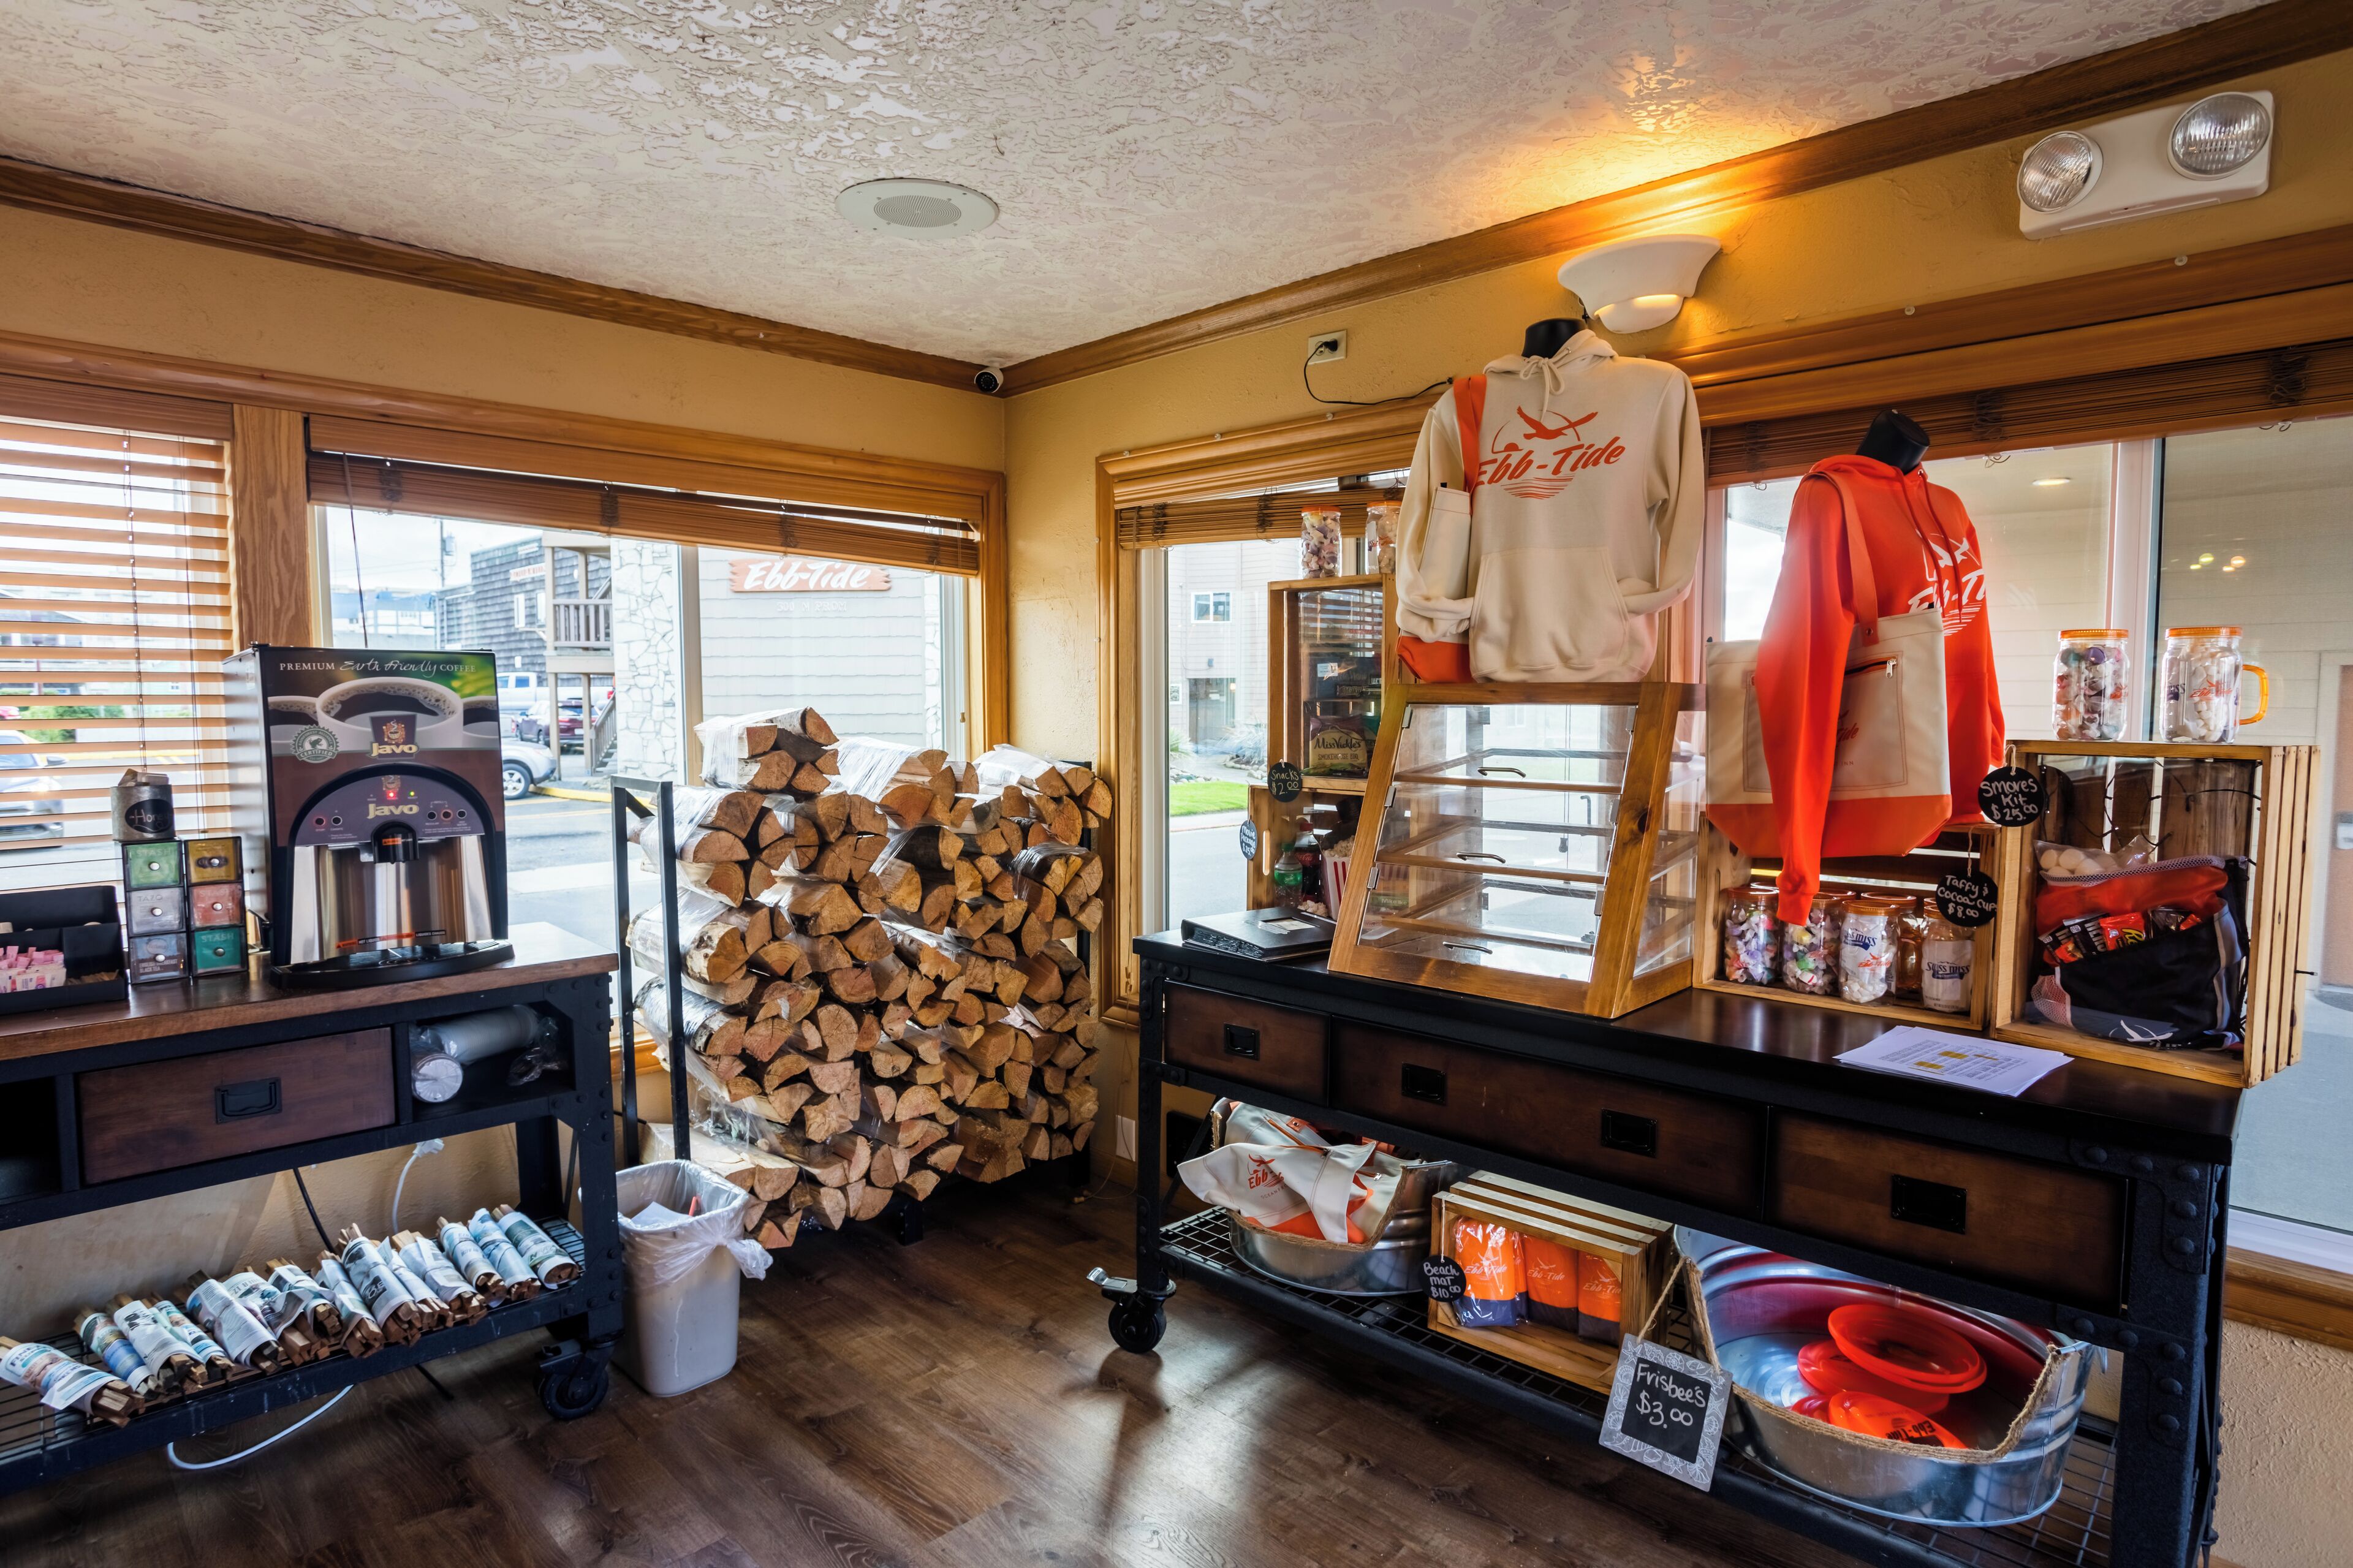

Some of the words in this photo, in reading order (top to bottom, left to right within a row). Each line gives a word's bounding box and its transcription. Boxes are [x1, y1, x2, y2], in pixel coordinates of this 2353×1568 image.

[743, 560, 872, 589] Ebb-Tide
[776, 600, 795, 613] 300
[801, 601, 810, 612] N
[814, 600, 848, 613] PROM
[279, 662, 335, 671] PREMIUM
[339, 658, 381, 672] Earth
[384, 660, 437, 678] Friendly
[439, 664, 476, 673] COFFEE
[300, 749, 333, 758] CERTIFIED
[370, 741, 419, 757] Javo
[1270, 768, 1299, 781] Snacks
[1271, 781, 1300, 795] $2.00
[1980, 778, 2038, 797] Smores
[2001, 792, 2028, 808] Kit
[366, 803, 420, 819] Javo
[1991, 803, 2039, 821] $25.00
[1945, 874, 1979, 899] Taffy
[1947, 903, 1979, 918] $8.00
[200, 933, 235, 942] STASH
[1423, 1262, 1460, 1276] Beach
[1526, 1268, 1566, 1281] Ebb-Tide
[1430, 1286, 1461, 1298] $10.00
[1636, 1363, 1706, 1408] Frisbee's
[1635, 1389, 1694, 1429] $3.00
